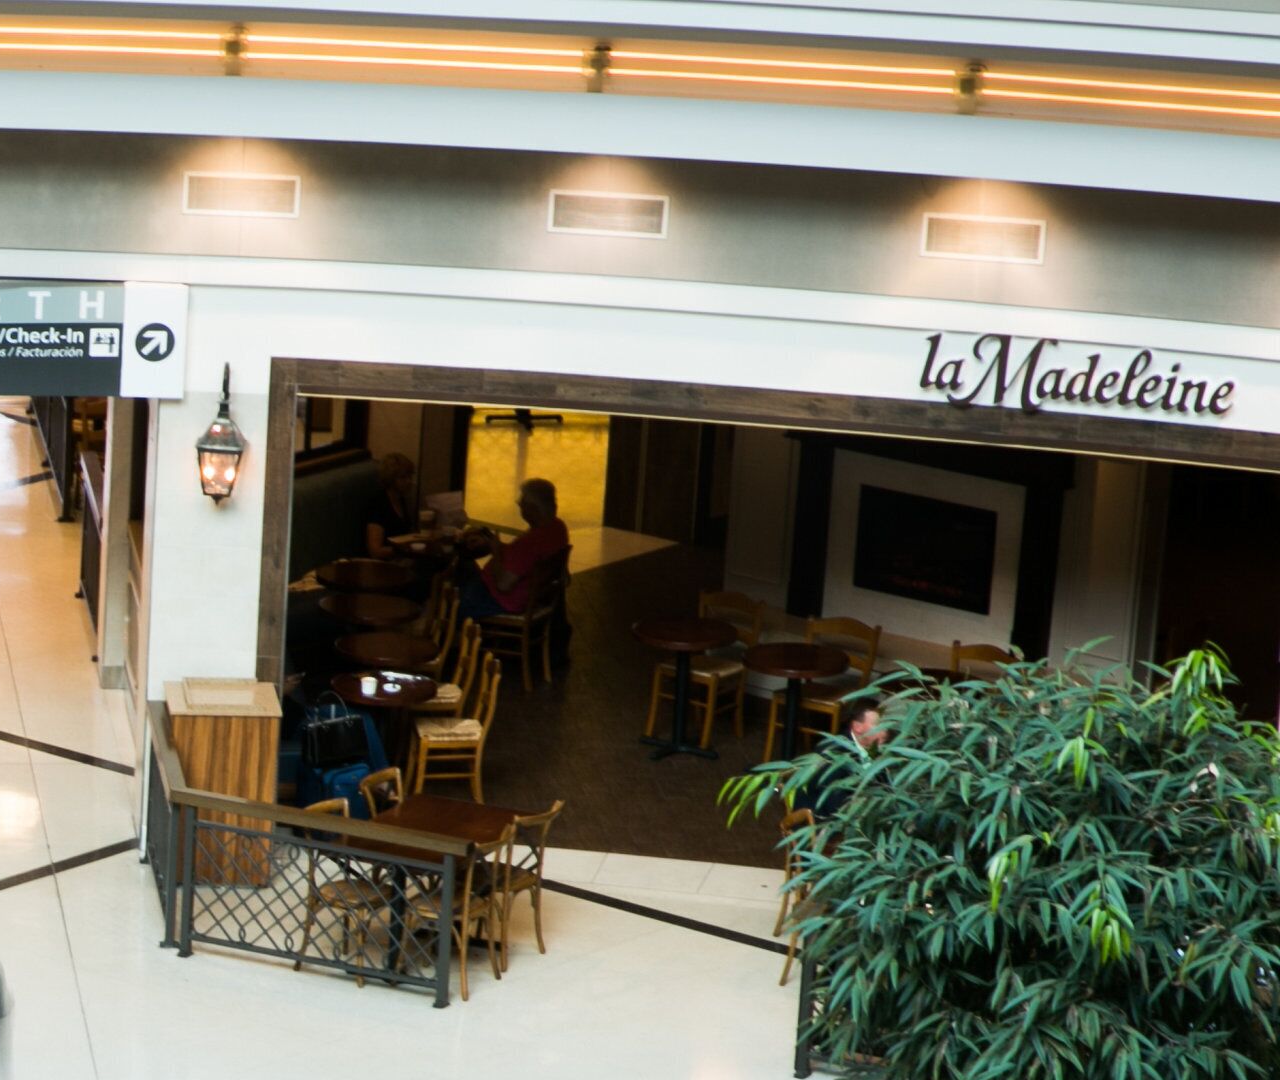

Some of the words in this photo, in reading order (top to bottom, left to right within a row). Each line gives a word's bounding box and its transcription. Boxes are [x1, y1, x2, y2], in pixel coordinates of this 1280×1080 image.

[15, 346, 84, 358] Facturación
[919, 332, 965, 391] la
[947, 333, 1235, 413] Madeleine
